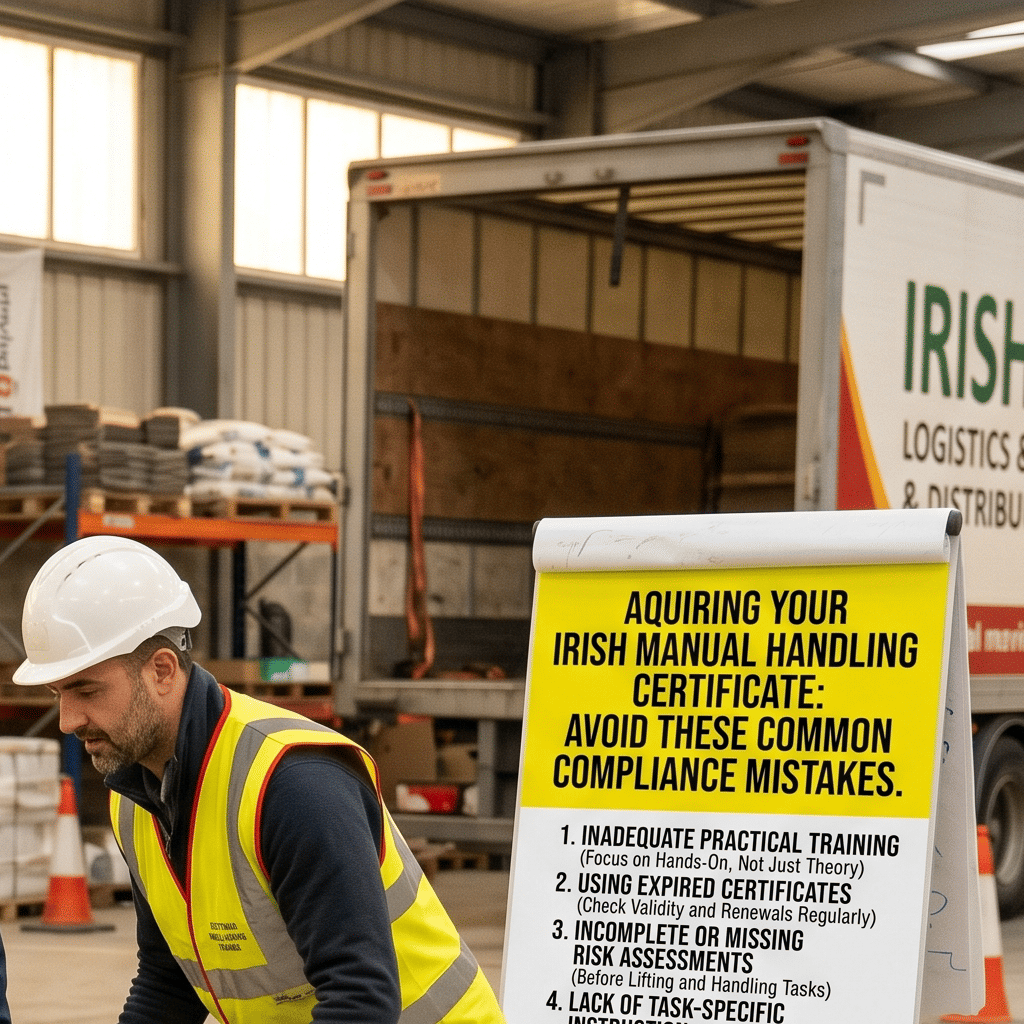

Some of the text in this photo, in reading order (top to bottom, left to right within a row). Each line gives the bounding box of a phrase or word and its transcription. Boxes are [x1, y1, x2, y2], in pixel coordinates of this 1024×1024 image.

[904, 280, 1024, 406] IRISH
[902, 420, 1011, 470] LOGISTICS
[624, 589, 848, 628] AQUIRING YOUR
[553, 632, 918, 668] IRISH MANUAL HANDLING
[633, 673, 824, 709] CERTIFICATE:
[564, 713, 892, 753] AVOID THESE COMMON
[553, 754, 902, 797] COMPLIANCE MISTAKES.
[561, 824, 900, 857] 1. INADEQUATE PRACTICAL TRAINING
[580, 849, 864, 880] (Focus on Hands-On, Not Just Theory)
[555, 871, 852, 905] 2. USING EXPIRED CERTIFICATES
[577, 896, 876, 929] (Check Validity and Renewals Regularly)
[552, 919, 804, 951] 3. INCOMPLETE OR MISSING
[573, 944, 754, 975] RISK ASSESSMENTS
[571, 968, 831, 1002] (Before Lifting and Handling Tasks)
[546, 990, 785, 1024] 4. LACK OF TASK-SPECIFIC
